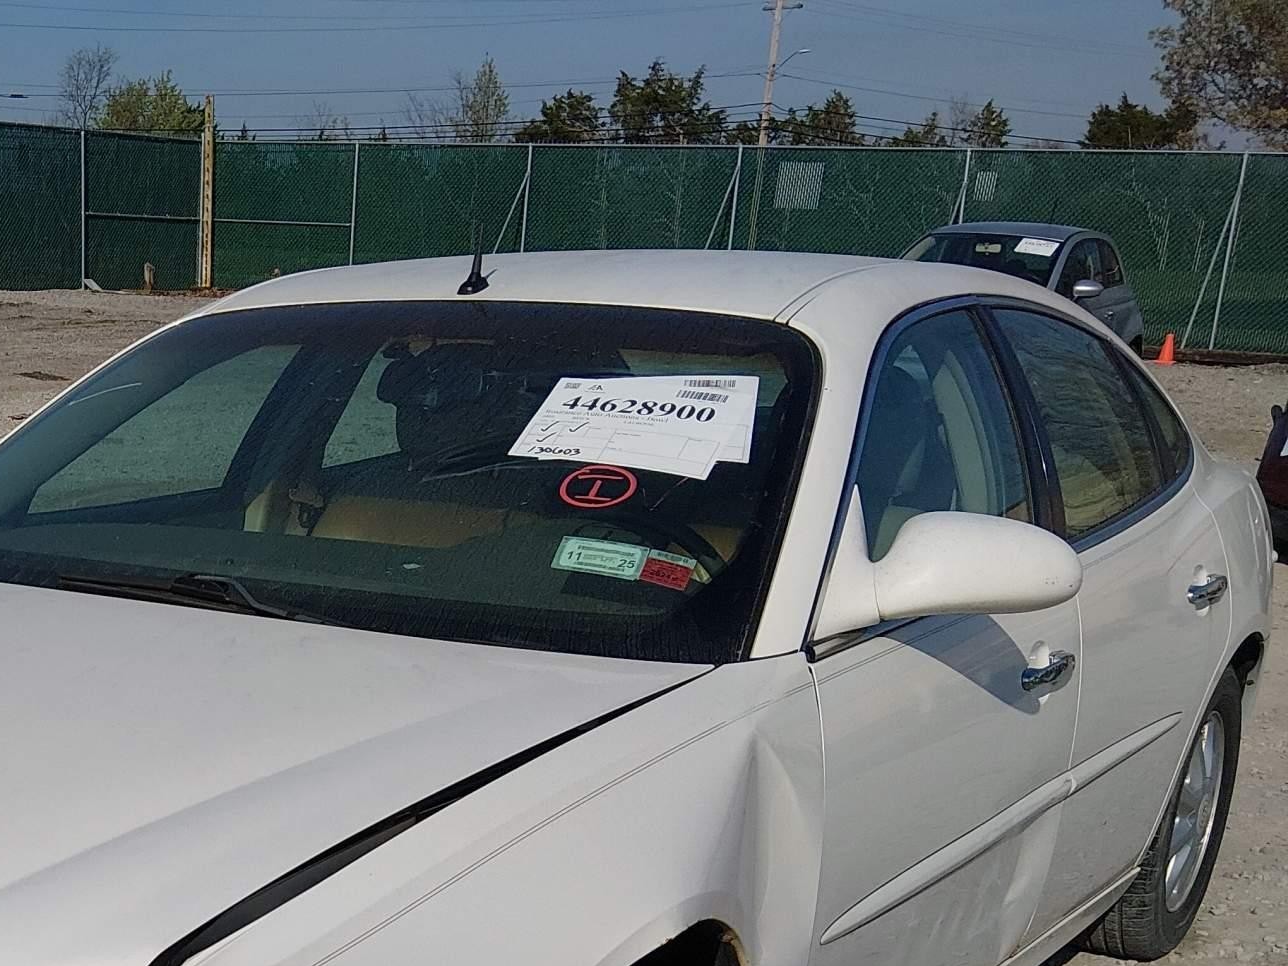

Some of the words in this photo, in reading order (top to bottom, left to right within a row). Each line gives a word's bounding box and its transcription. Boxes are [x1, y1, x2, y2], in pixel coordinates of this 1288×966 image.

[562, 395, 716, 423] 44628900
[567, 550, 583, 561] 11
[617, 558, 636, 569] 25
